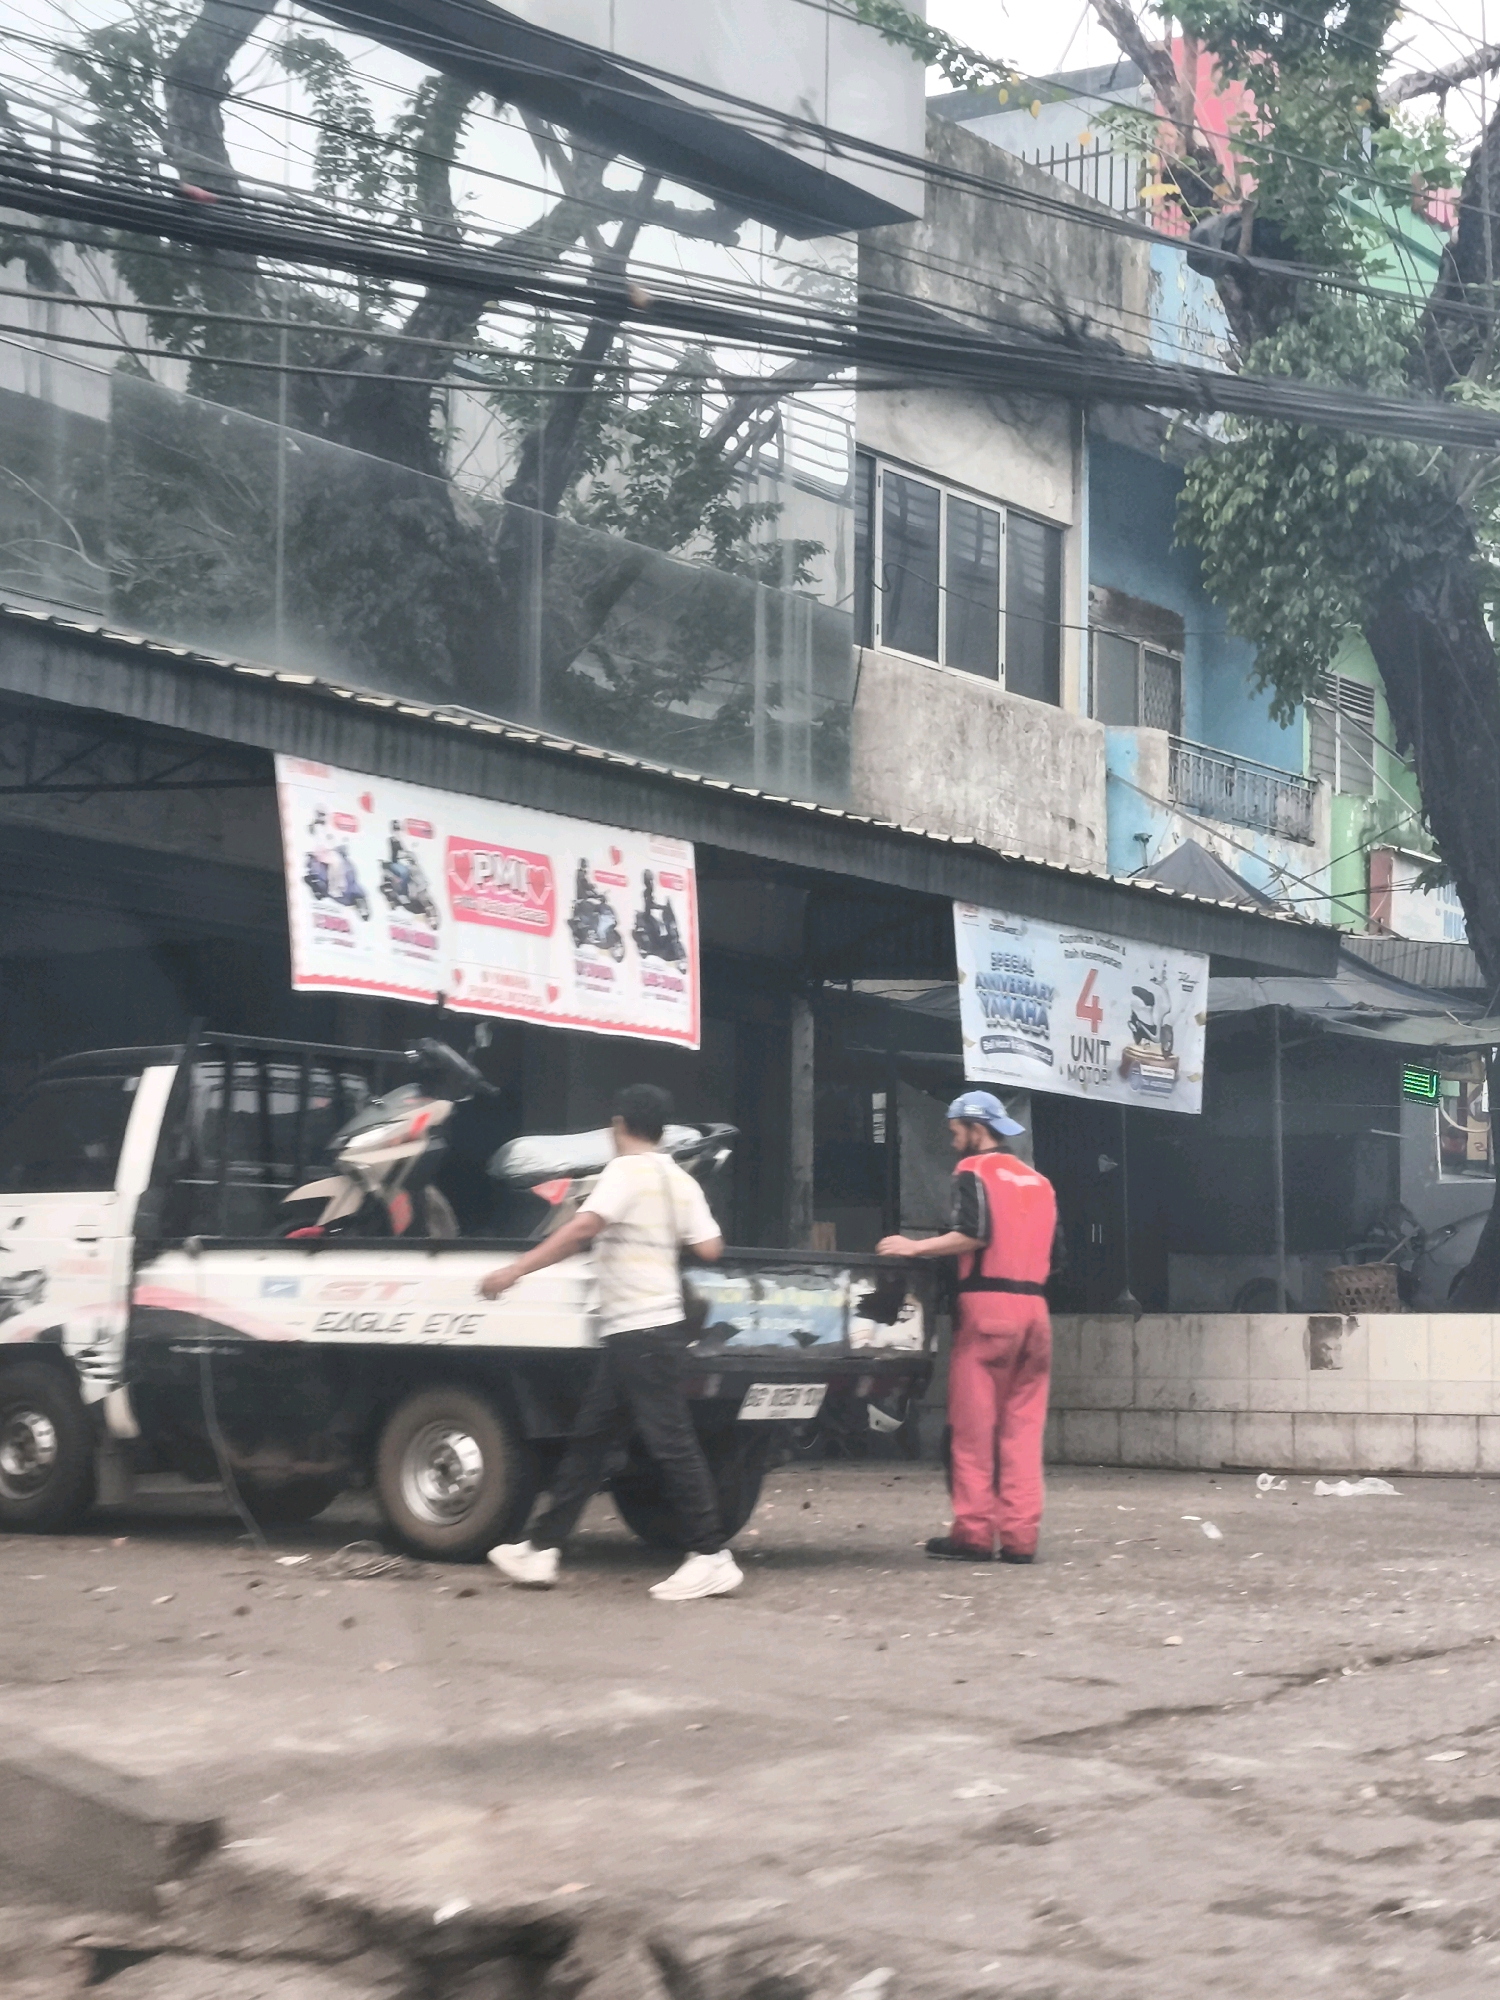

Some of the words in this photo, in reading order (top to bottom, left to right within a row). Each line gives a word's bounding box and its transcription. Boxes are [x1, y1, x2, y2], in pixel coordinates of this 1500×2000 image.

[1076, 968, 1103, 1035] 4
[1071, 1035, 1111, 1066] UNIT
[311, 1310, 416, 1333] EAGLE
[421, 1311, 487, 1335] EYE
